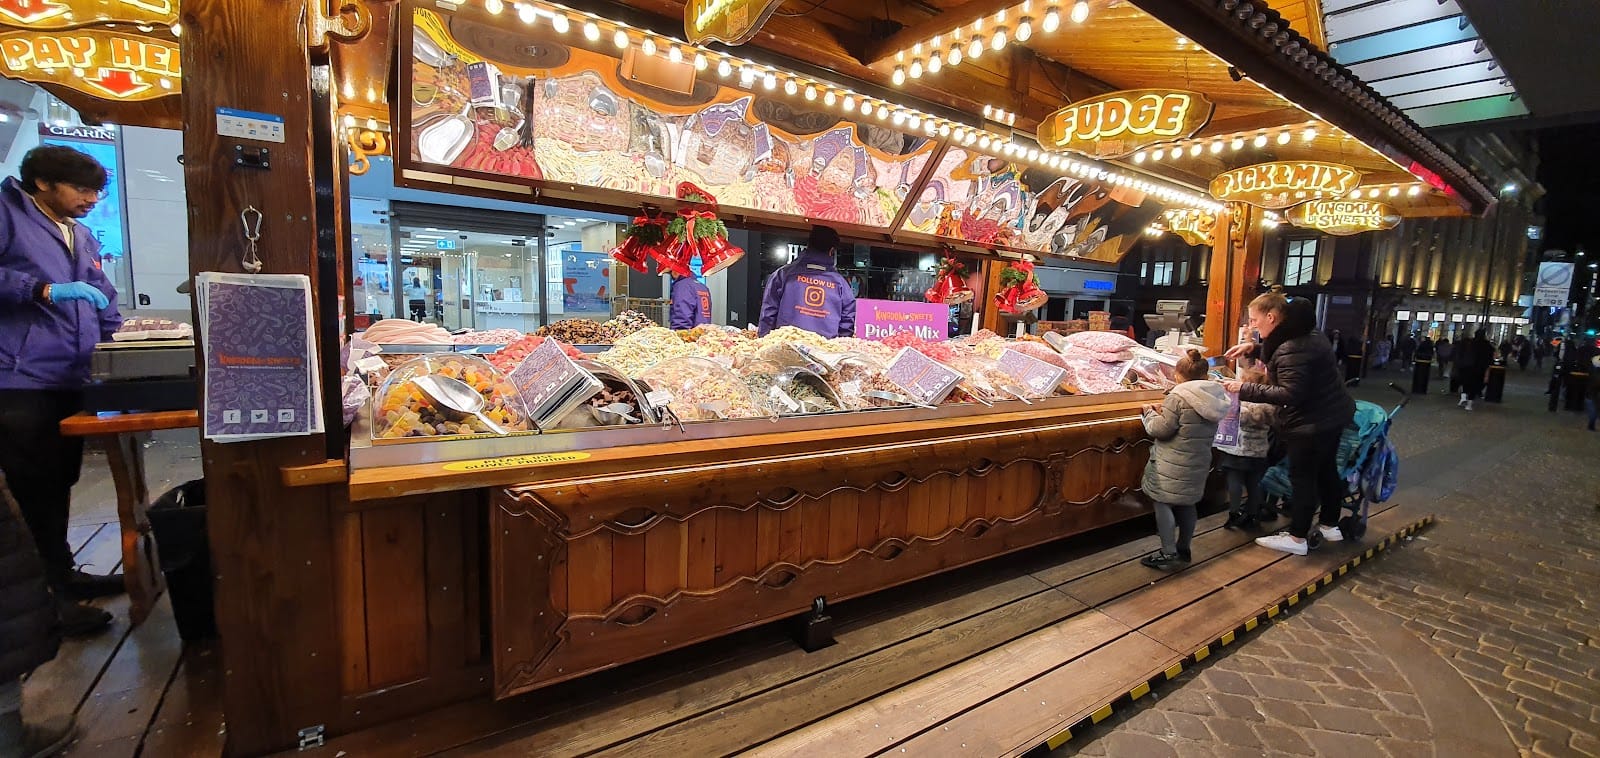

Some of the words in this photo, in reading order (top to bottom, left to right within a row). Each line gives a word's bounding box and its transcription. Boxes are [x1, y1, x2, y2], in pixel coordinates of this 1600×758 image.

[1, 37, 96, 70] PAY
[1055, 94, 1190, 146] FUDGE
[1305, 201, 1380, 216] KINGDOM
[1317, 215, 1382, 228] SWEETS
[797, 275, 826, 287] FOLLOW
[876, 309, 905, 321] KINGDOM
[910, 312, 934, 321] SWEETS
[914, 325, 940, 339] Mix
[484, 456, 525, 464] PLEASE
[517, 456, 576, 464] PROVIDED
